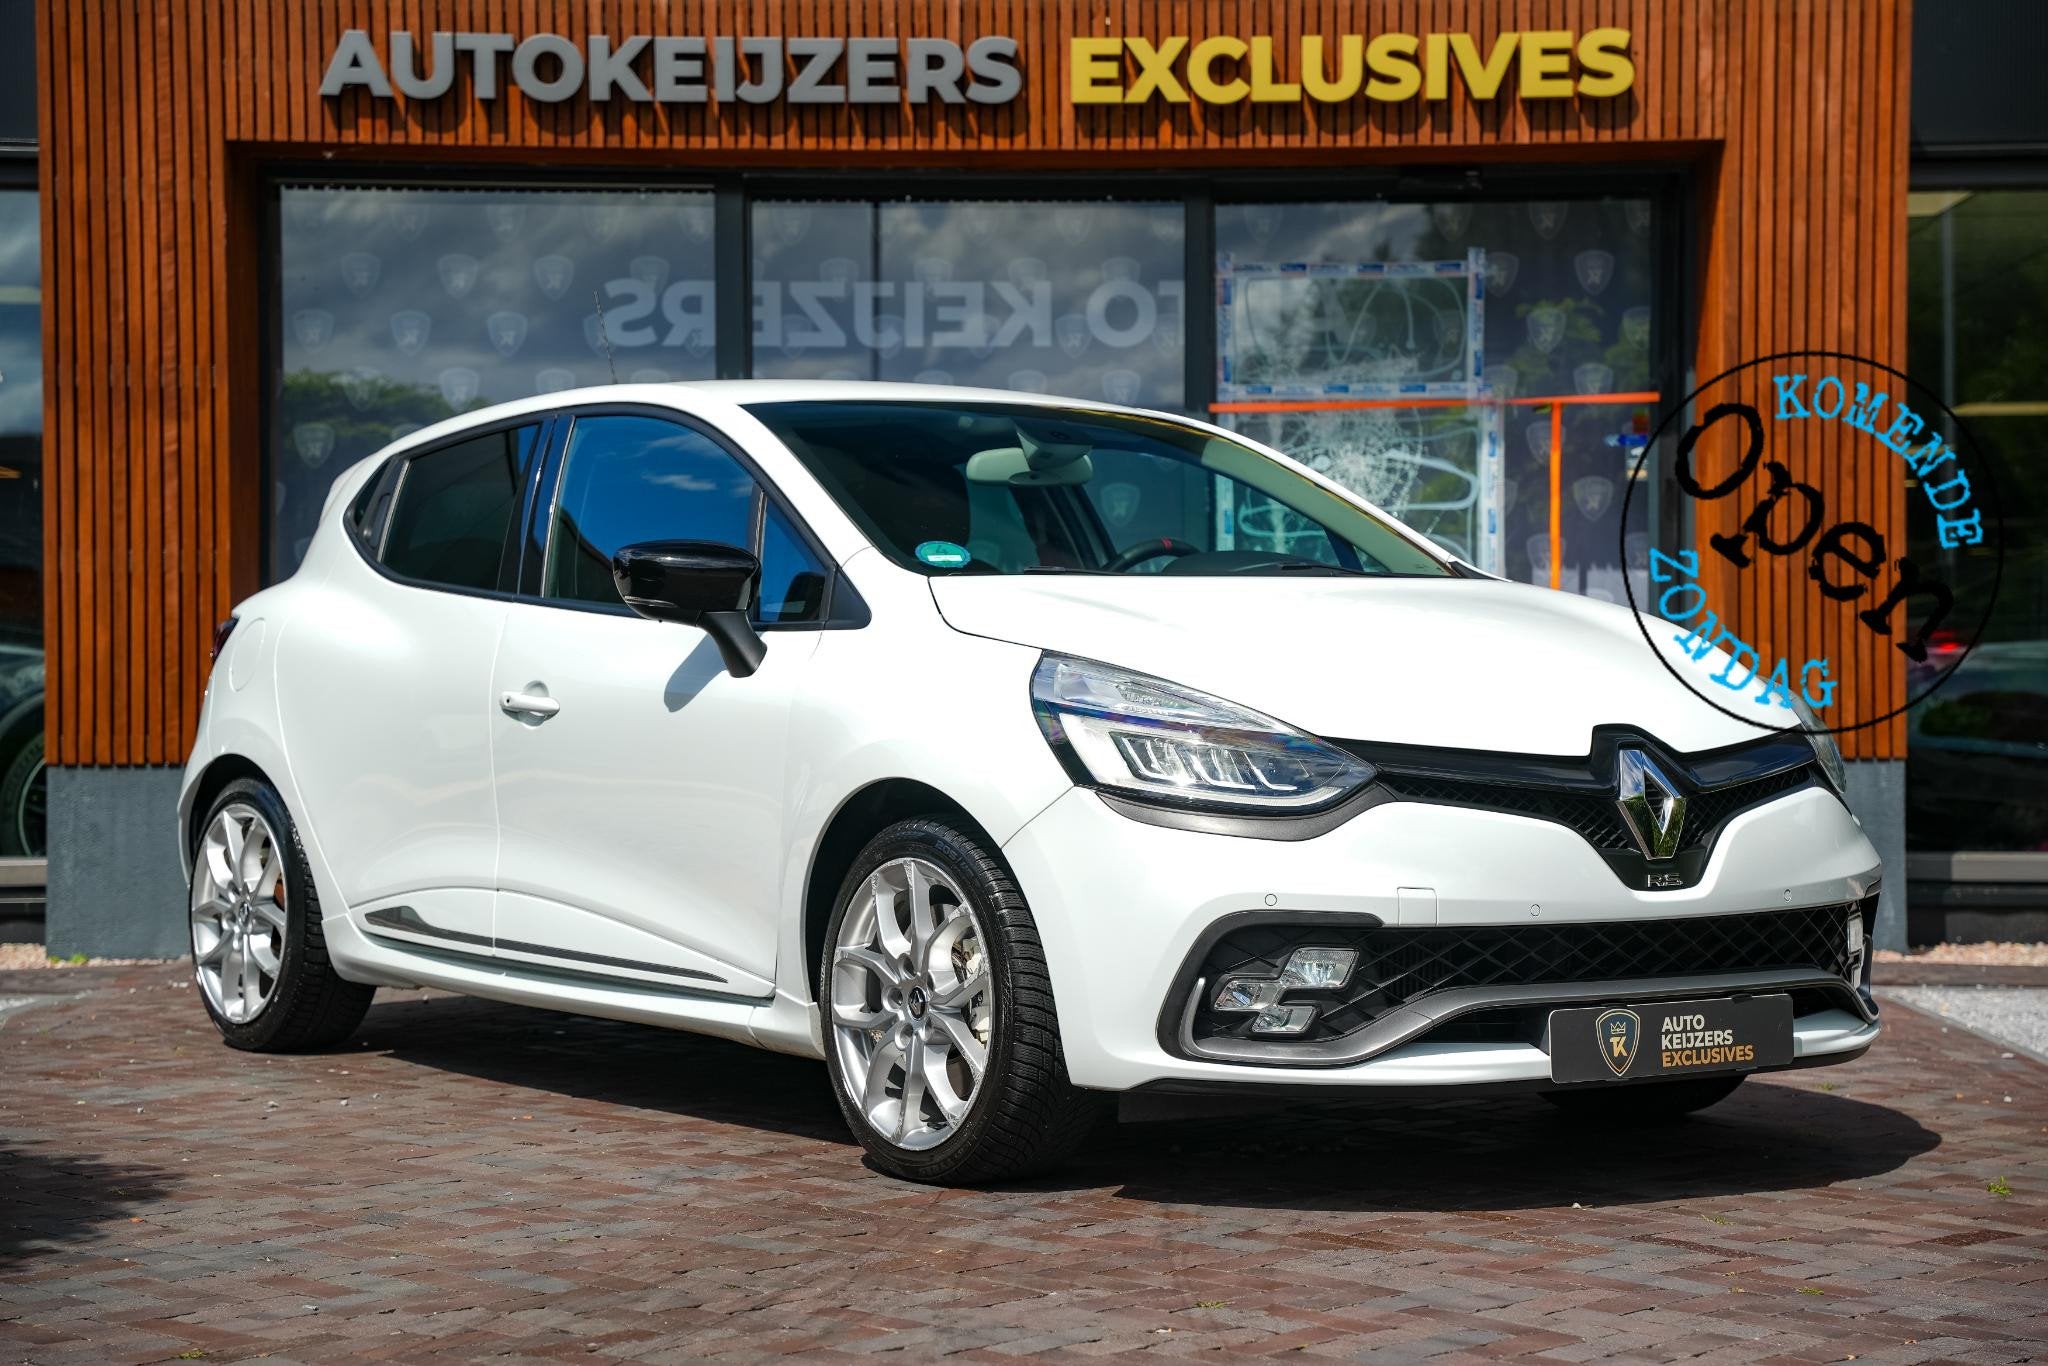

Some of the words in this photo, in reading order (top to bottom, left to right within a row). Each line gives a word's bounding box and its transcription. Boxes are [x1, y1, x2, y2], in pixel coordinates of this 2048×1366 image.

[1070, 27, 1636, 106] EXCLUSIVES
[1661, 1014, 1705, 1033] AUTO
[1661, 1029, 1734, 1051] KEIJZERS
[1662, 1045, 1754, 1068] EXCLUSIVES
